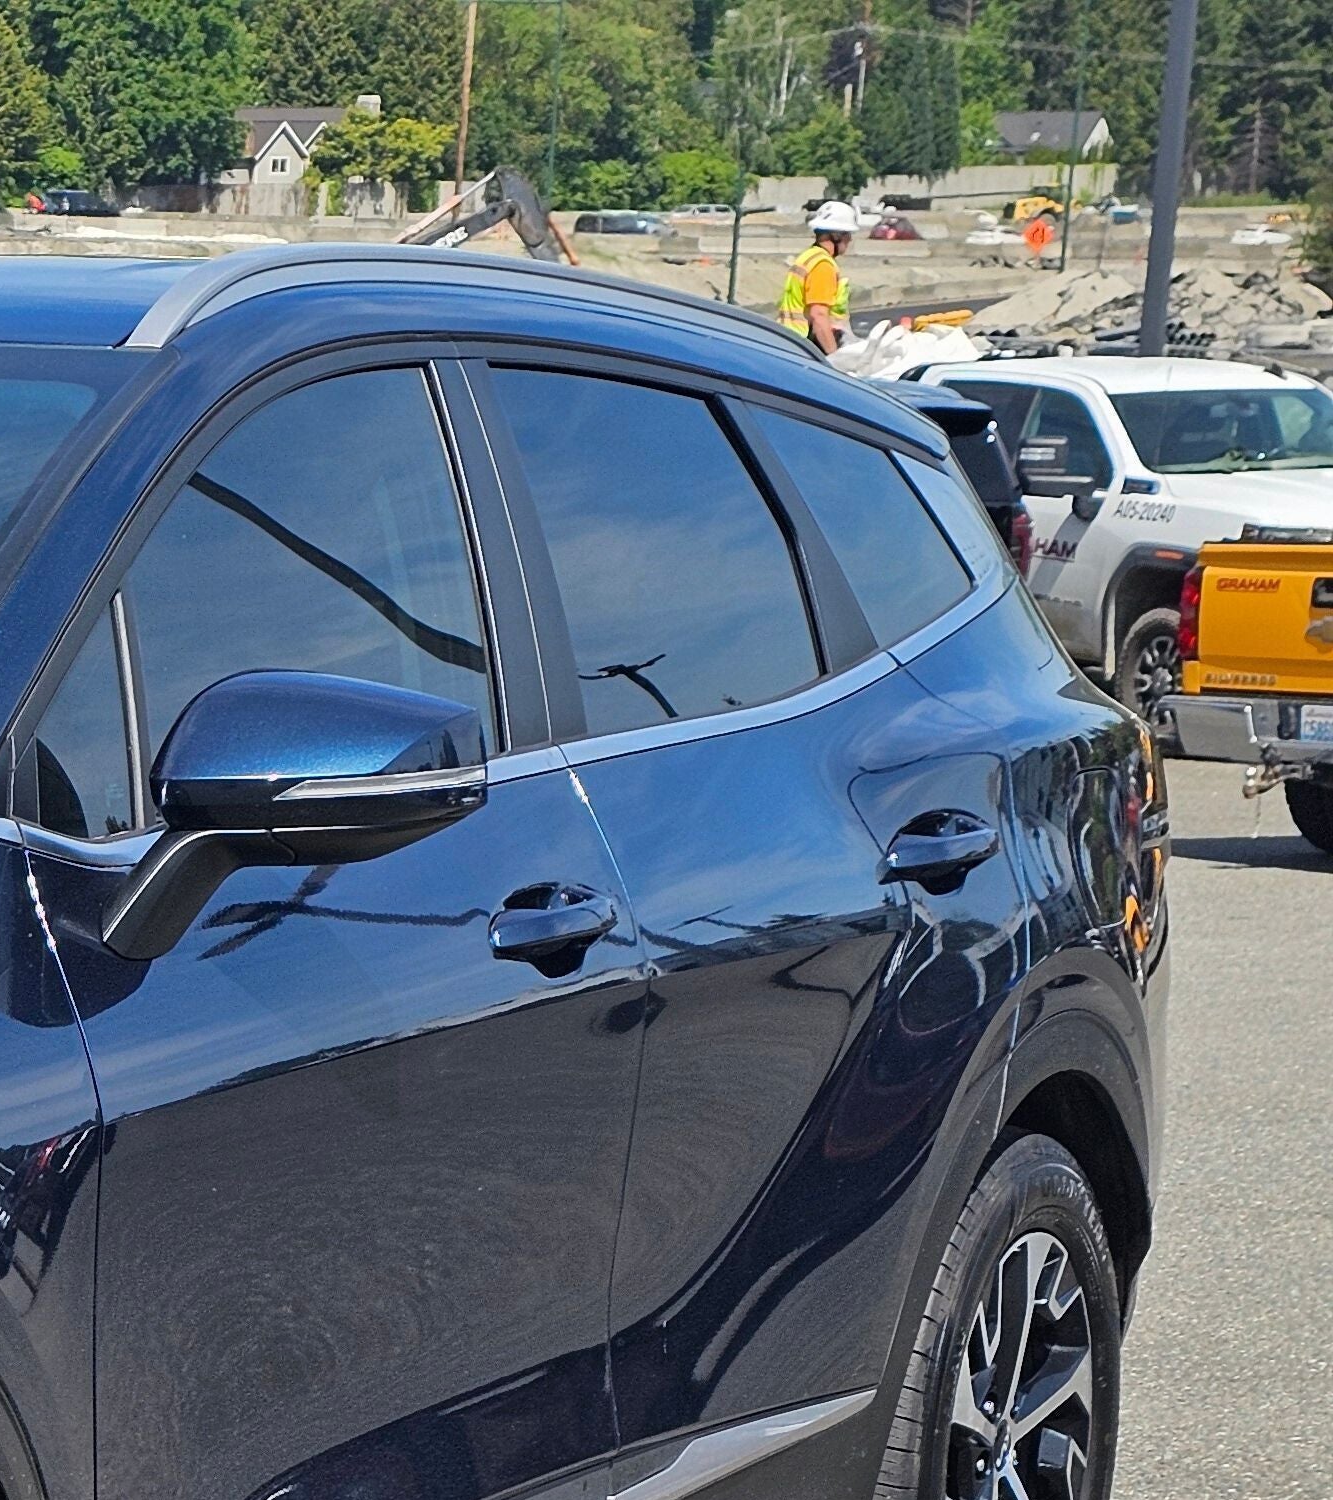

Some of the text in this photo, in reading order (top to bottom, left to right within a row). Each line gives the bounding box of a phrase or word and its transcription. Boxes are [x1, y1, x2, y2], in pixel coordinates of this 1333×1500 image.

[1111, 499, 1177, 524] A05-20240
[1033, 537, 1079, 559] HAM
[1215, 576, 1281, 593] GRAHAM
